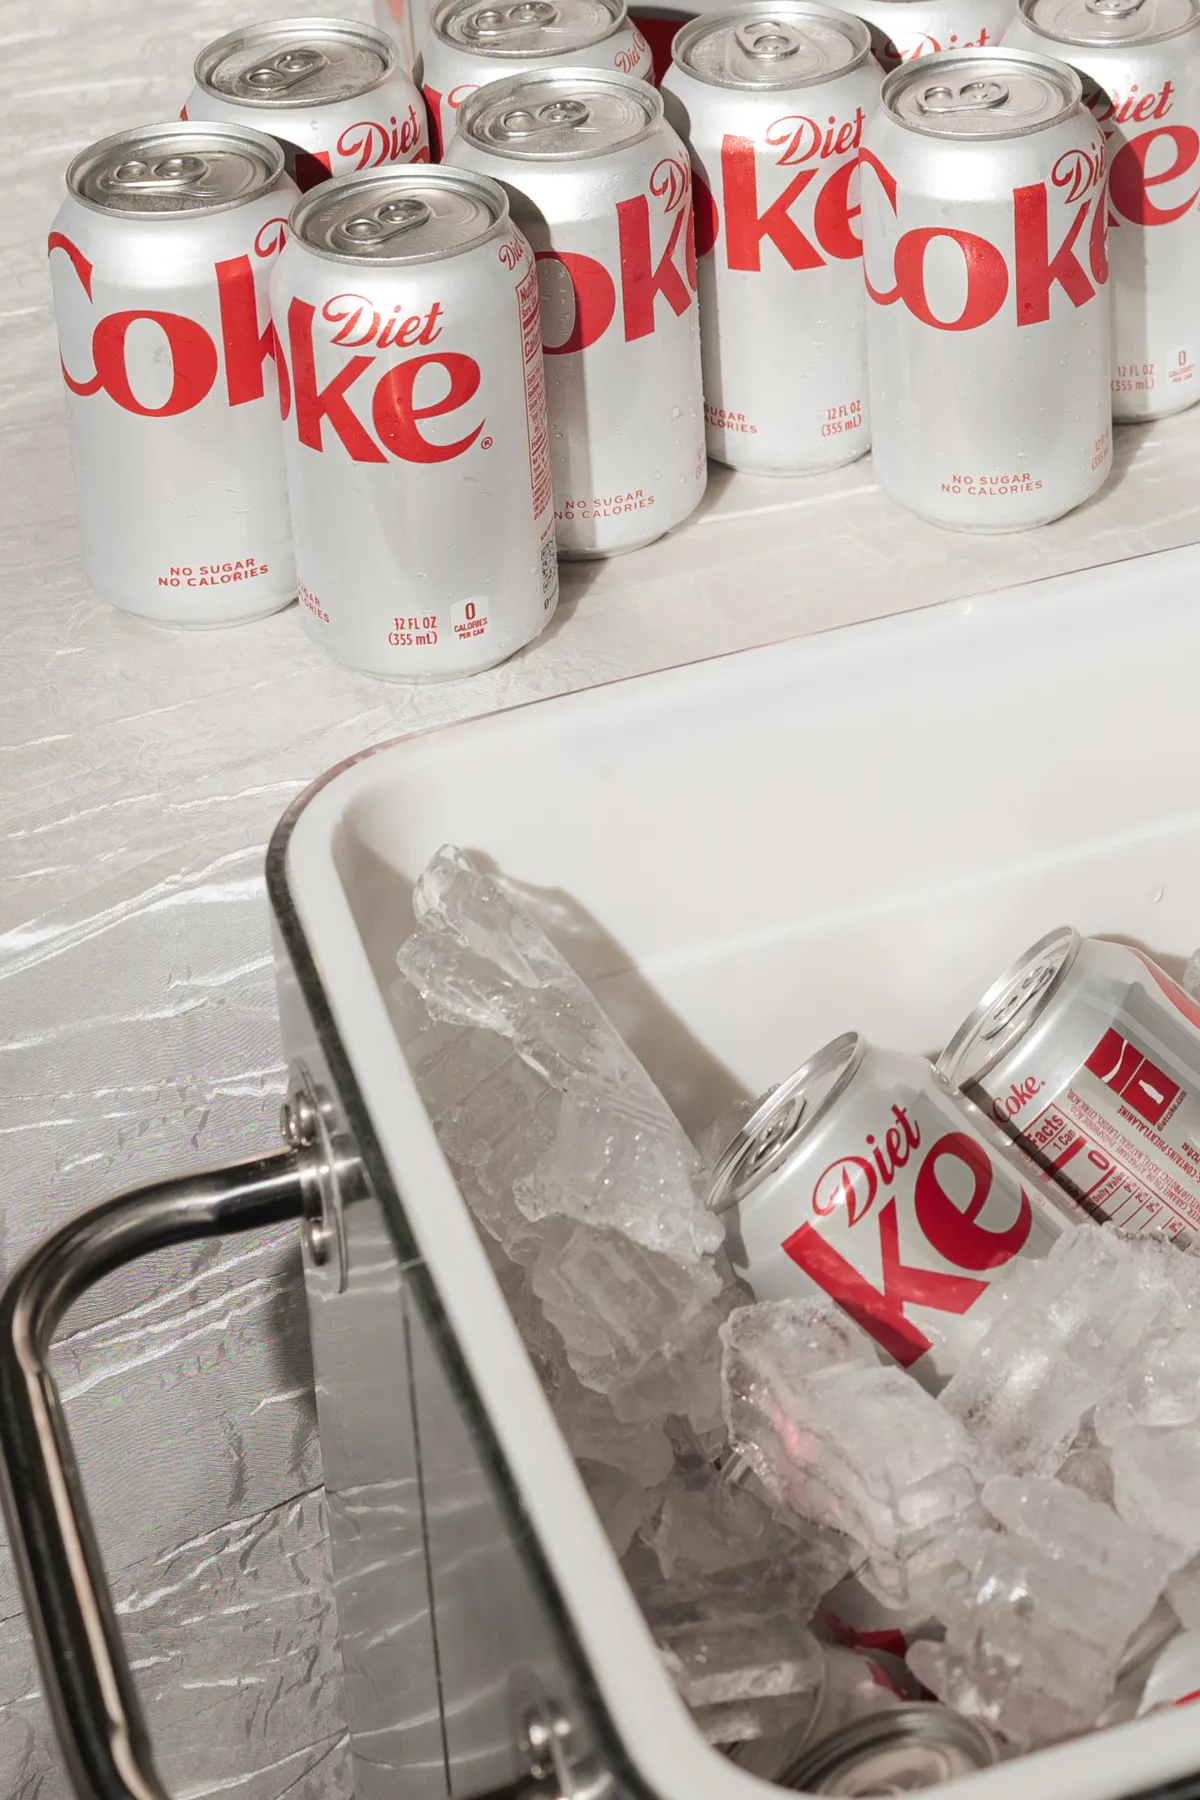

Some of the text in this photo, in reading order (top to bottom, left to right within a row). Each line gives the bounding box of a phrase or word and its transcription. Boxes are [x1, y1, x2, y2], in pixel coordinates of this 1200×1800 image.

[336, 104, 422, 171] Diet
[765, 107, 865, 167] Diet
[859, 147, 1109, 332] Cok
[321, 293, 444, 349] Diet
[1178, 350, 1187, 366] 0
[1117, 366, 1126, 377] 12
[1129, 365, 1139, 377] FL
[1143, 364, 1154, 375] OZ
[1111, 377, 1155, 392] (355 mL)
[827, 399, 862, 421] 12 FL OZ
[704, 414, 758, 434] ALORIES
[821, 414, 862, 438] (355 mL)
[941, 480, 1043, 496] NO CALORIES
[952, 472, 1031, 485] NO SUGAR
[554, 495, 656, 521] NO CALORIES
[565, 489, 644, 509] NO SUGAR
[158, 564, 270, 588] NO CALORIES
[170, 557, 256, 577] NO SUGAR
[464, 601, 476, 621] 0
[394, 615, 437, 631] 12 FL OZ
[453, 616, 489, 633] CALORIES
[388, 631, 438, 646] (355 mL)
[458, 627, 486, 641] PER CAN
[1156, 1089, 1188, 1132] dietcoke.com
[1024, 1108, 1065, 1151] Facts
[1056, 1126, 1076, 1146] Can
[1113, 1104, 1171, 1152] PHENYLALANINE
[812, 1104, 922, 1229] Diet
[1088, 1149, 1111, 1171] 0
[1163, 1146, 1199, 1178] CONTAINS
